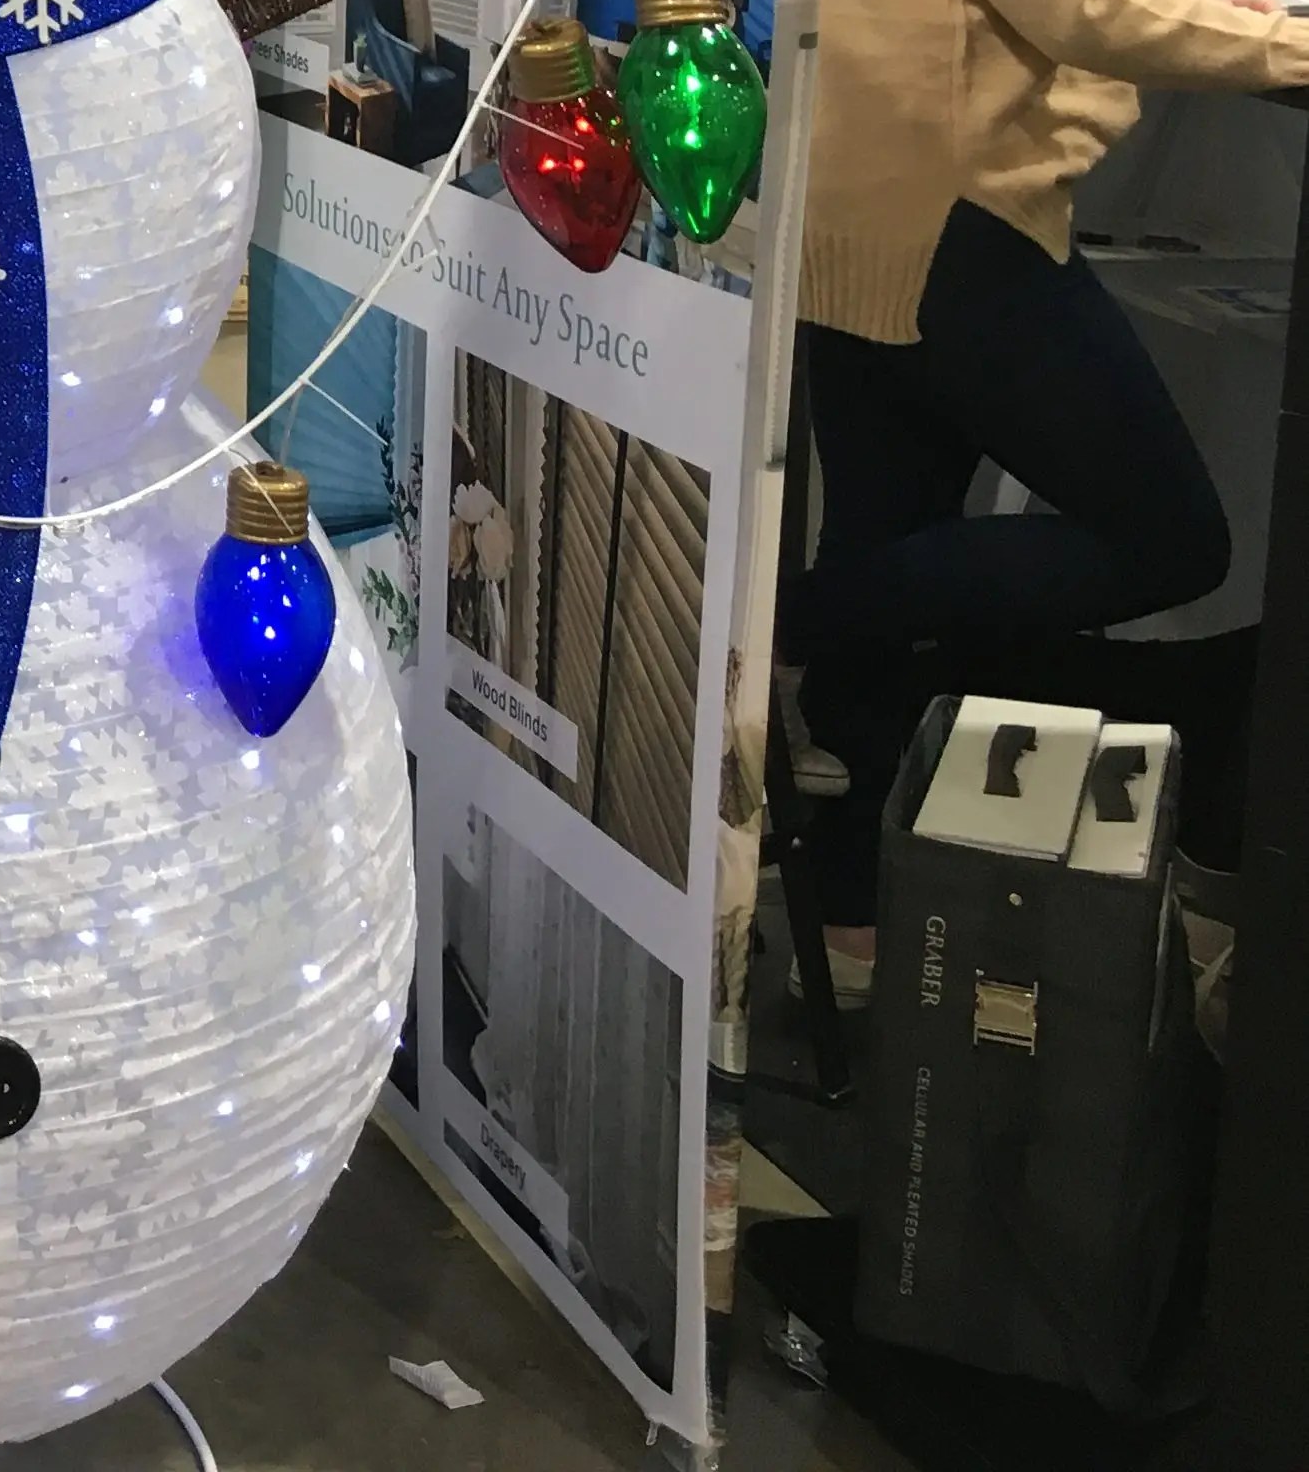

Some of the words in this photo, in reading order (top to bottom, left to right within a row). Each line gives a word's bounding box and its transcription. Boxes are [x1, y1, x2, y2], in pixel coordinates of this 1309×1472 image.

[283, 171, 392, 258] Solutions
[432, 241, 486, 305] Suit
[494, 268, 550, 346] Any
[560, 293, 649, 377] Space
[471, 669, 507, 715] Wood
[507, 691, 550, 744] Blinds
[920, 915, 947, 1009] GRABER
[479, 1120, 528, 1191] Drapery
